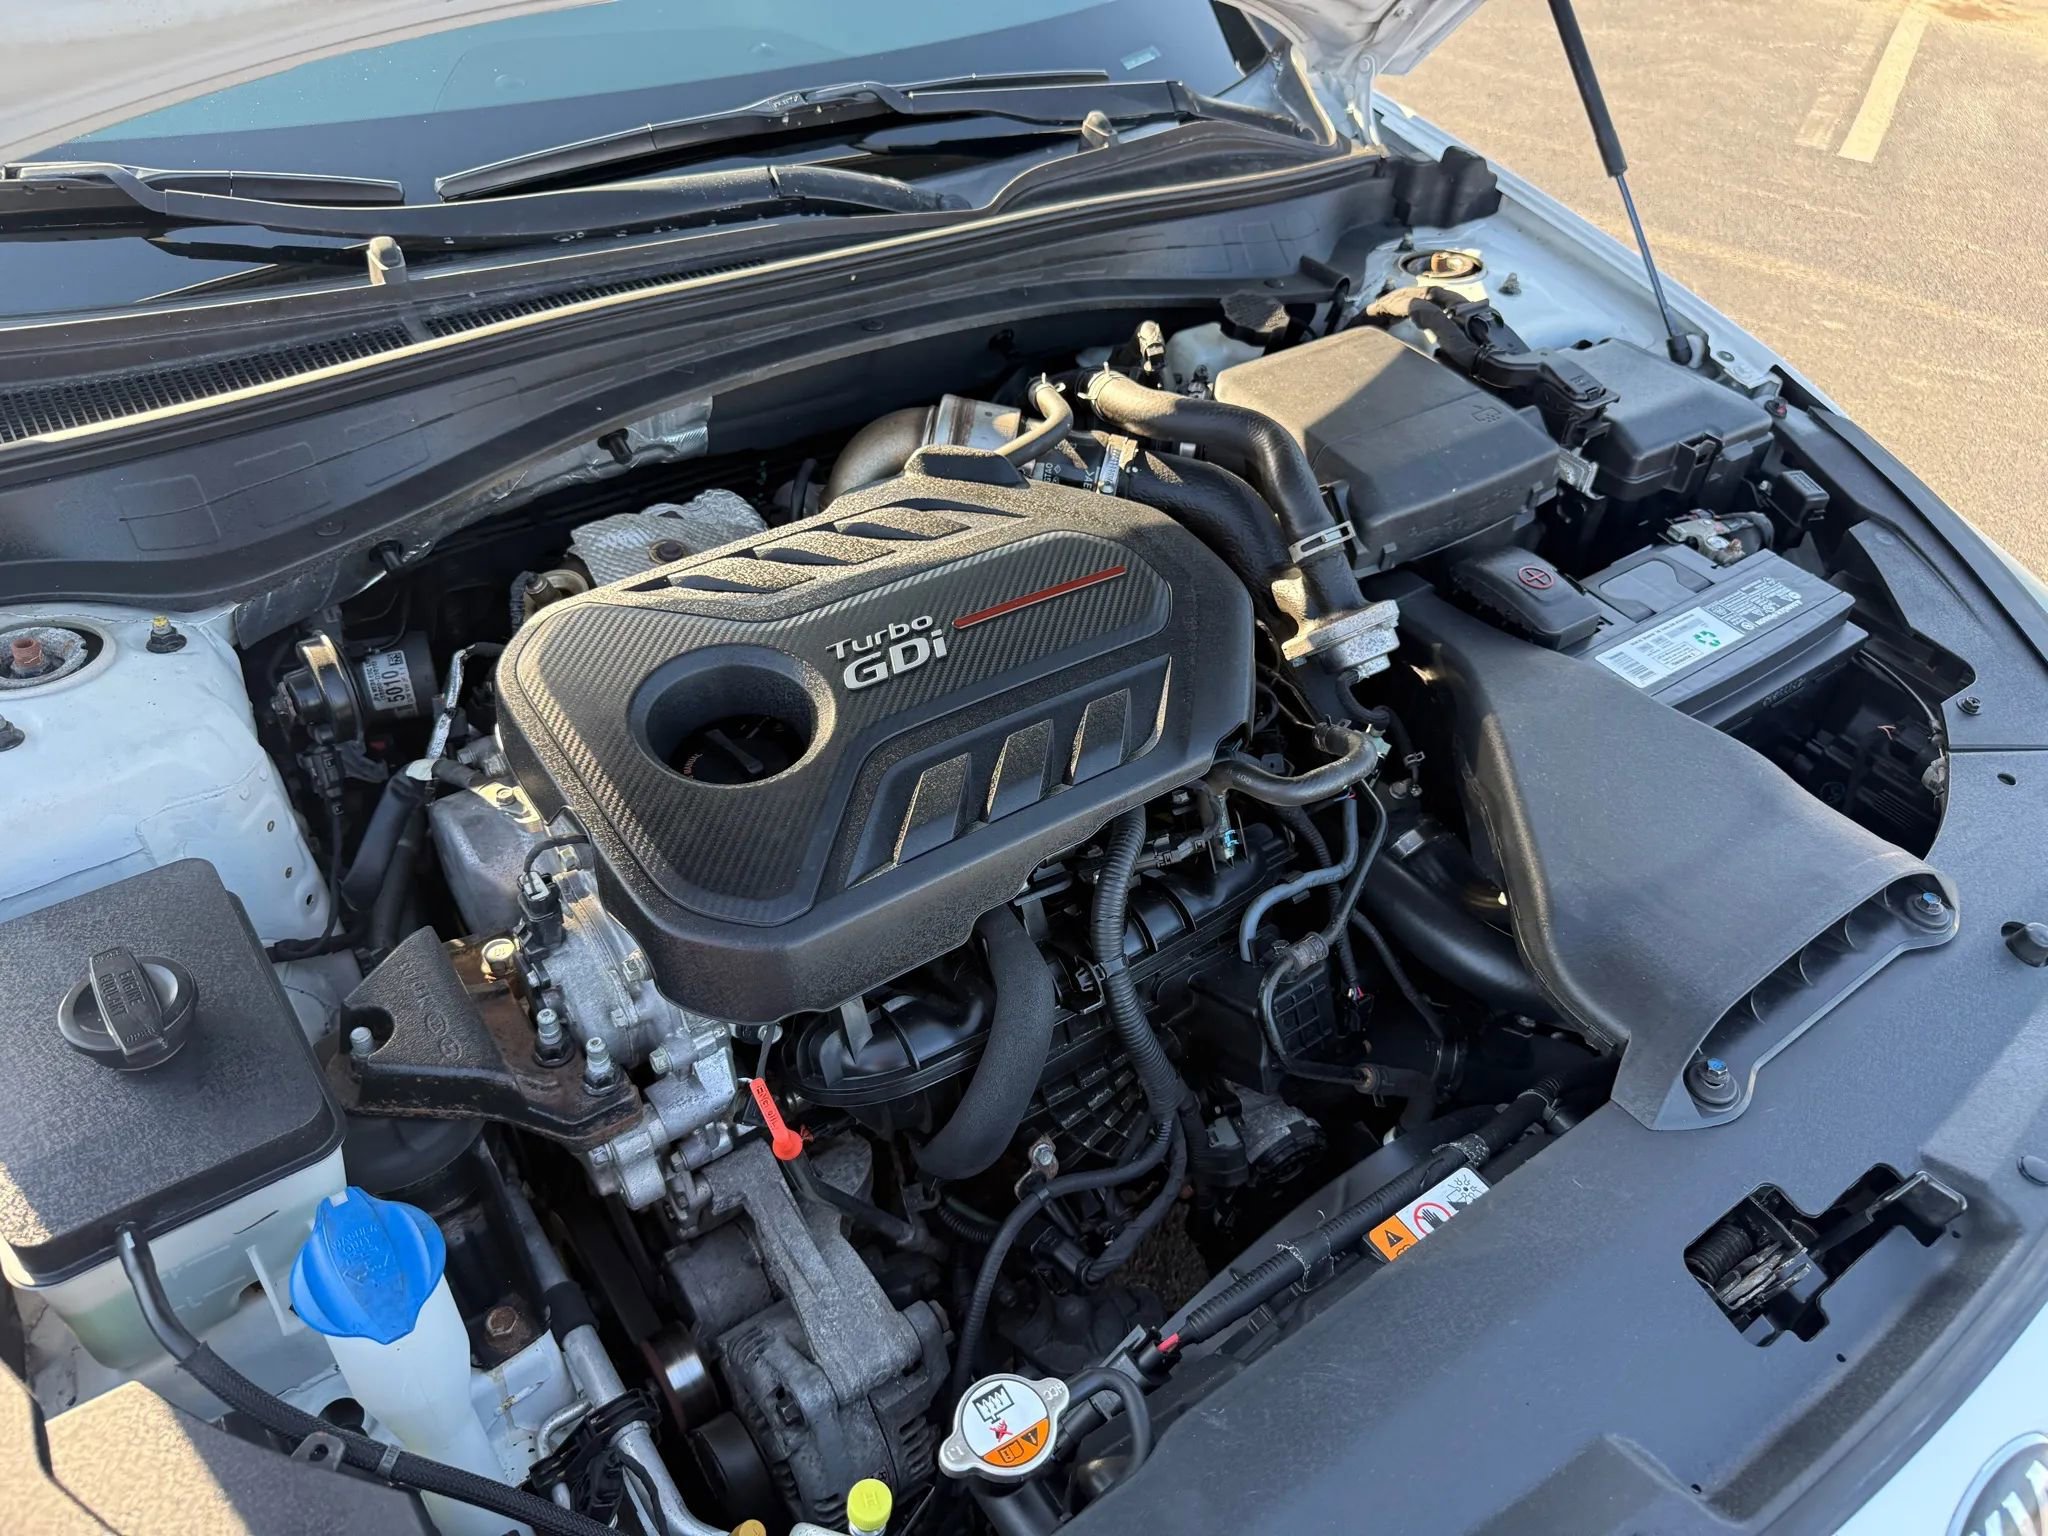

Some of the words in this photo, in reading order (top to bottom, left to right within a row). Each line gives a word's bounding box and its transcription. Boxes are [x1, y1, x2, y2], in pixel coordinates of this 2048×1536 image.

[826, 615, 933, 660] Turbo
[843, 629, 948, 690] GDi
[381, 670, 405, 703] 5010
[99, 973, 129, 1017] COOLANT
[118, 969, 145, 1006] ENGINE
